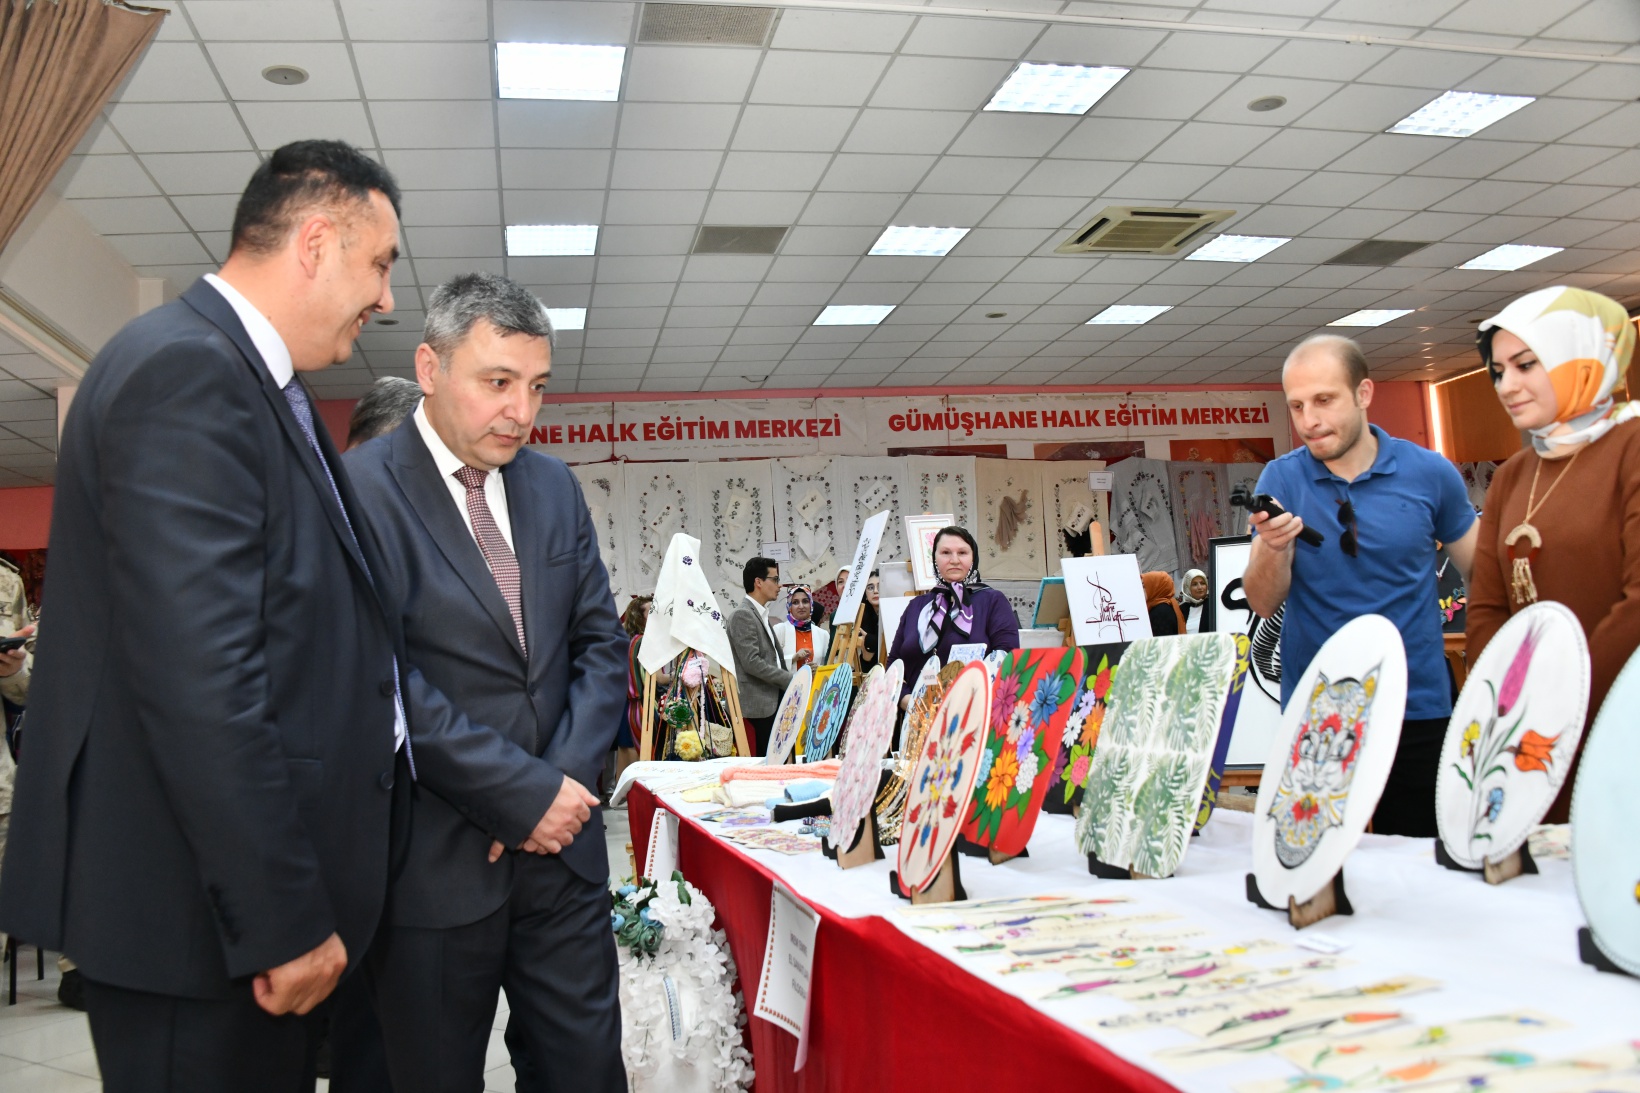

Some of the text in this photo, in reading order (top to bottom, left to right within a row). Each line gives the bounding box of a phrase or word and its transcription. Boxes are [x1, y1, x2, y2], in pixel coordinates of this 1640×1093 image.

[568, 422, 638, 443] HALK
[643, 416, 729, 441] EĞİTİM
[735, 413, 841, 438] MERKEZİ
[888, 402, 1270, 436] GÜMÜŞHANE HALK EĞİTİM MERKEZİ
